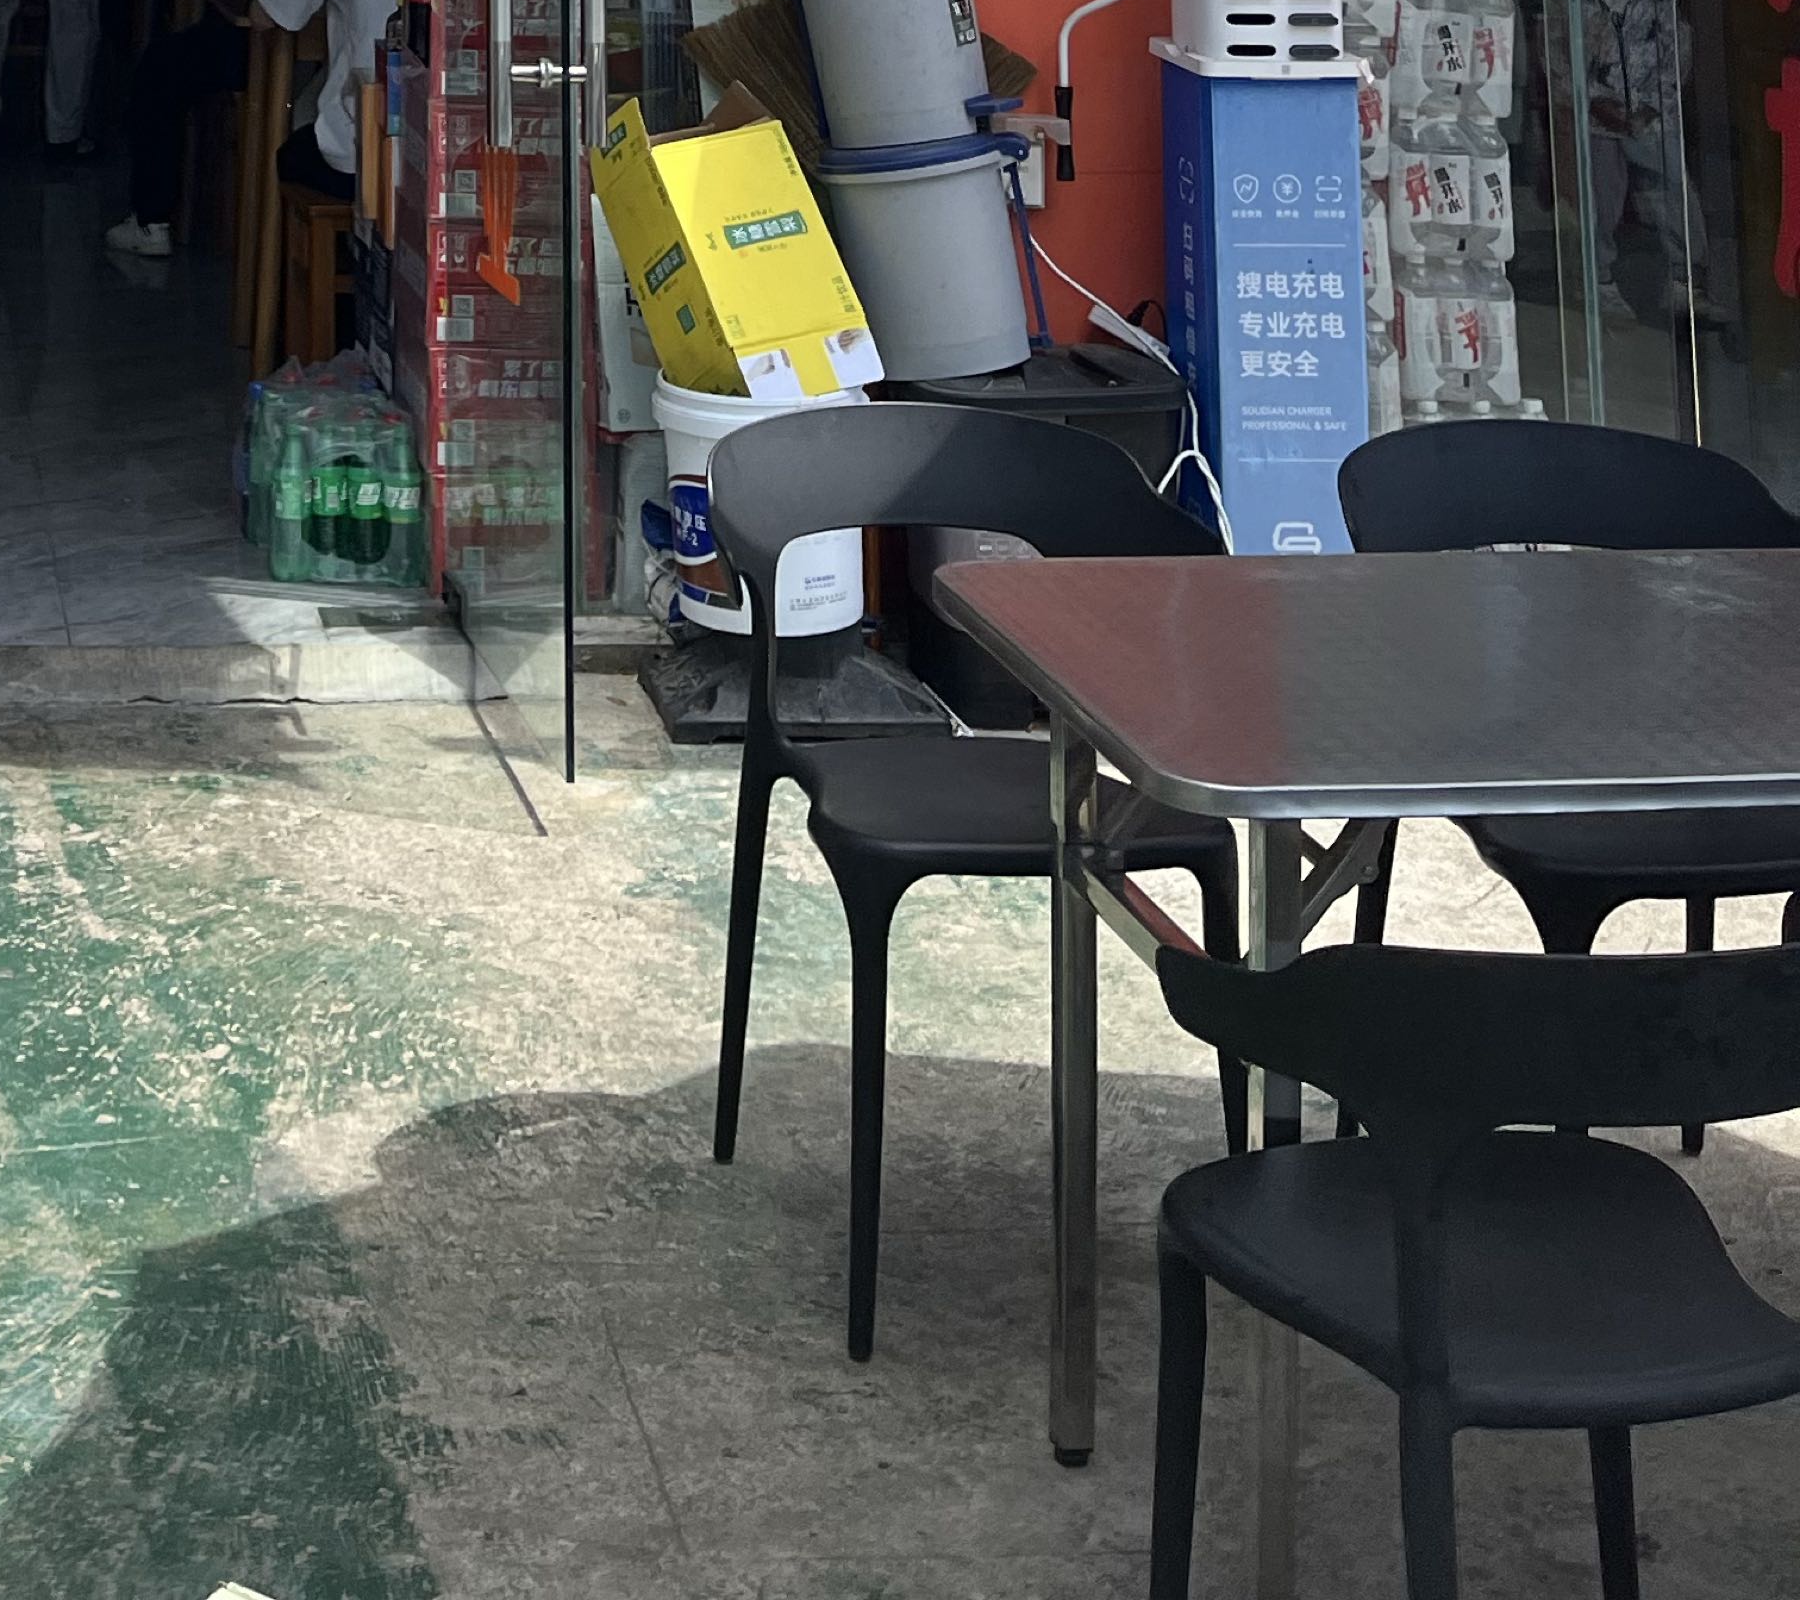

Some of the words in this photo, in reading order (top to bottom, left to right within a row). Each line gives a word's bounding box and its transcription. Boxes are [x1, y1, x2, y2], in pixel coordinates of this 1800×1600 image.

[1235, 270, 1346, 300] 搜电充电
[1238, 310, 1347, 340] 专业充电
[1239, 348, 1320, 379] 更安全
